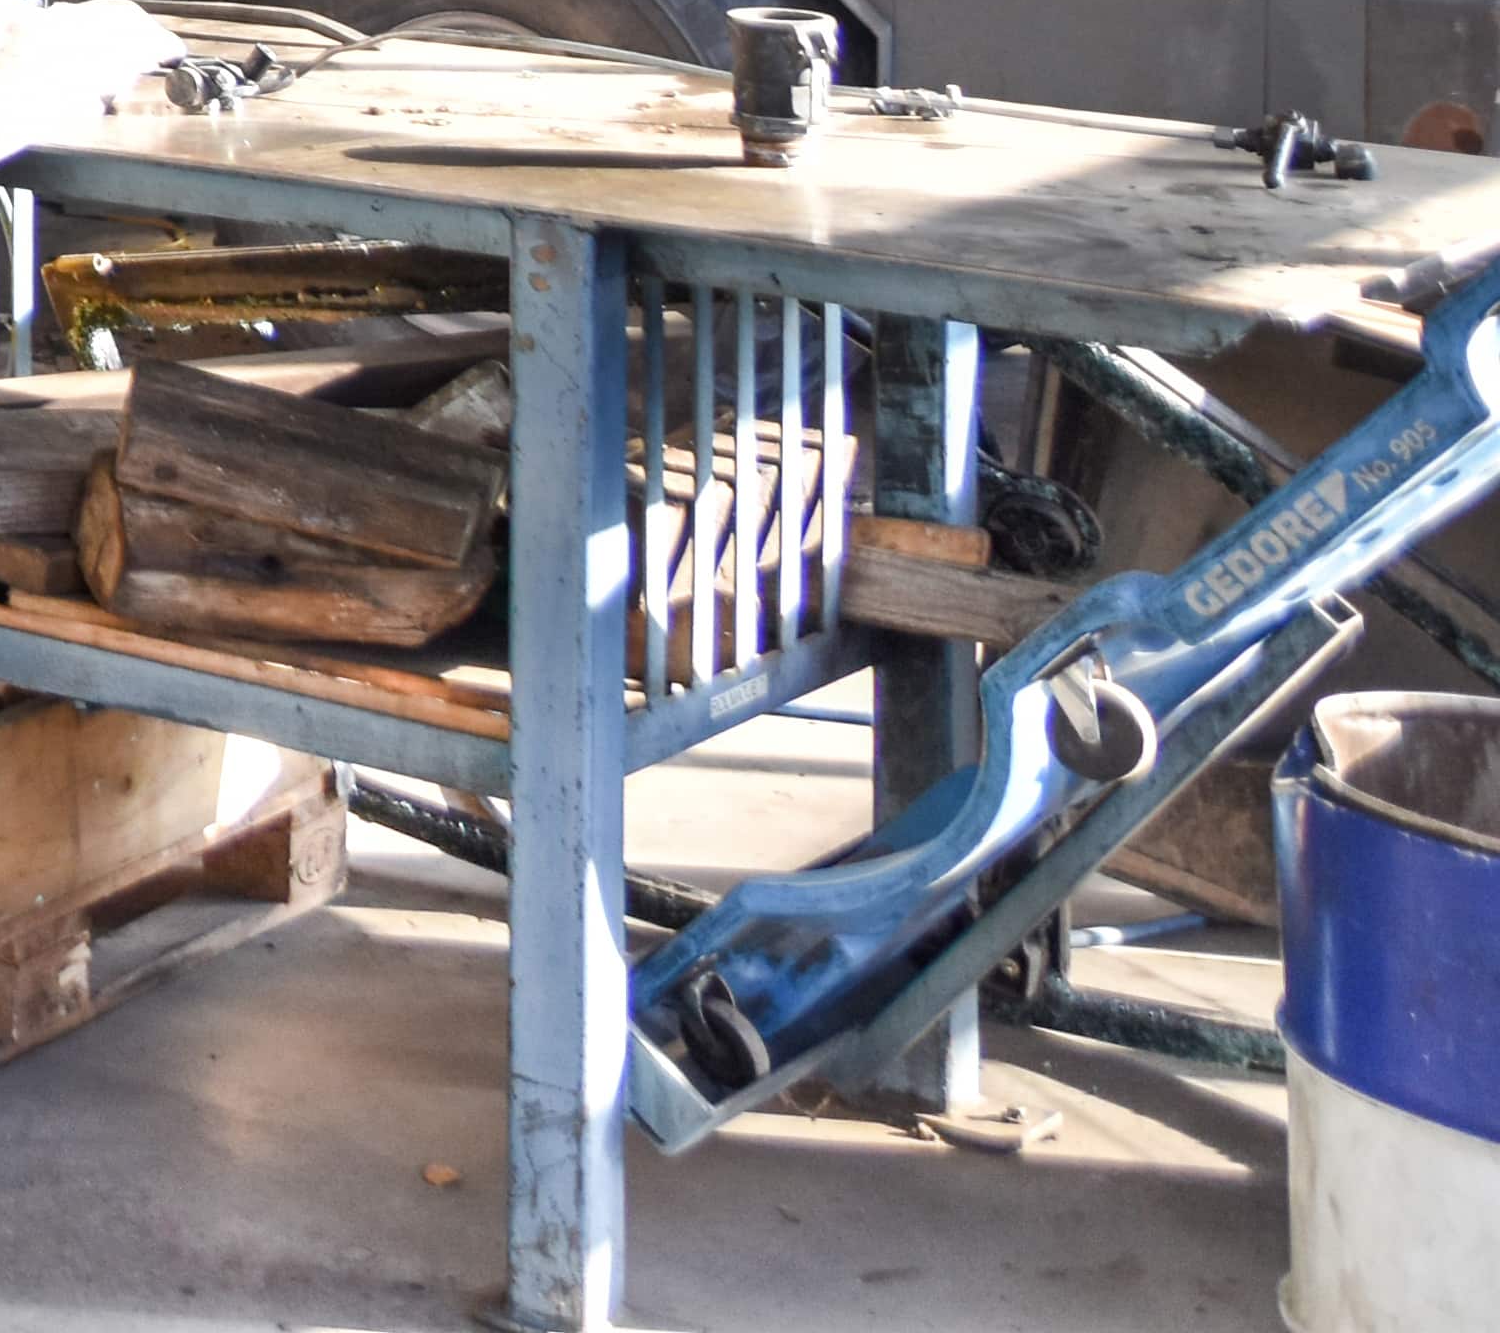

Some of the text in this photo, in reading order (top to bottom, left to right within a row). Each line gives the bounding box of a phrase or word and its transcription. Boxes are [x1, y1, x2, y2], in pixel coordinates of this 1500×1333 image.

[1183, 416, 1437, 617] GEDORE No. 905
